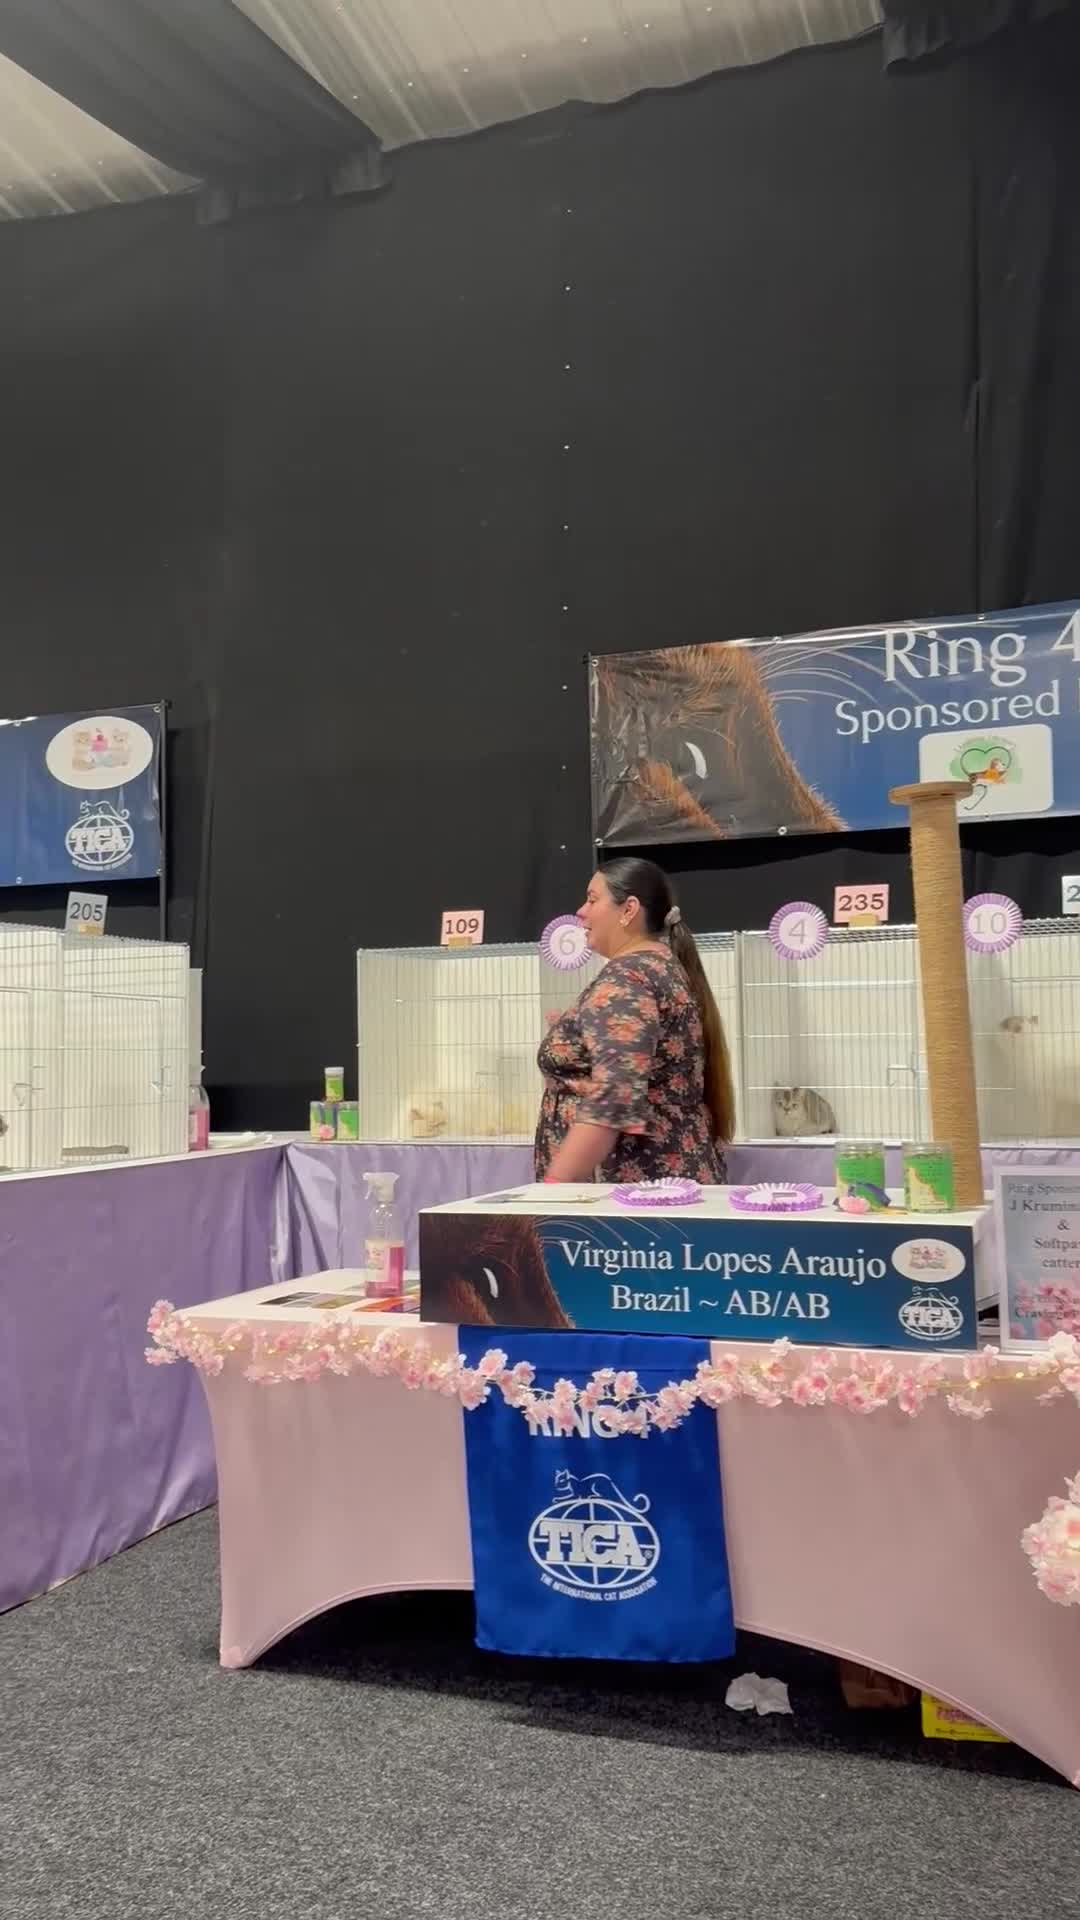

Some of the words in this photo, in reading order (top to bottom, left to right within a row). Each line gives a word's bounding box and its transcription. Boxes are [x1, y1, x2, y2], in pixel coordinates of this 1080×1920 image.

[884, 629, 1027, 687] Ring
[835, 679, 1061, 744] Sponsored
[71, 828, 129, 852] TICA
[70, 902, 104, 922] 205
[839, 893, 884, 911] 235
[445, 918, 479, 935] 109
[788, 918, 808, 944] 4
[973, 911, 1007, 934] 10
[559, 929, 576, 955] 6
[1057, 1219, 1071, 1231] &
[560, 1239, 674, 1275] Virginia
[681, 1242, 772, 1283] Lopes
[779, 1246, 887, 1285] Araujo
[609, 1284, 690, 1313] Brazil
[724, 1290, 831, 1320] AB/AB
[903, 1306, 957, 1328] TICA
[539, 1521, 648, 1567] TICA
